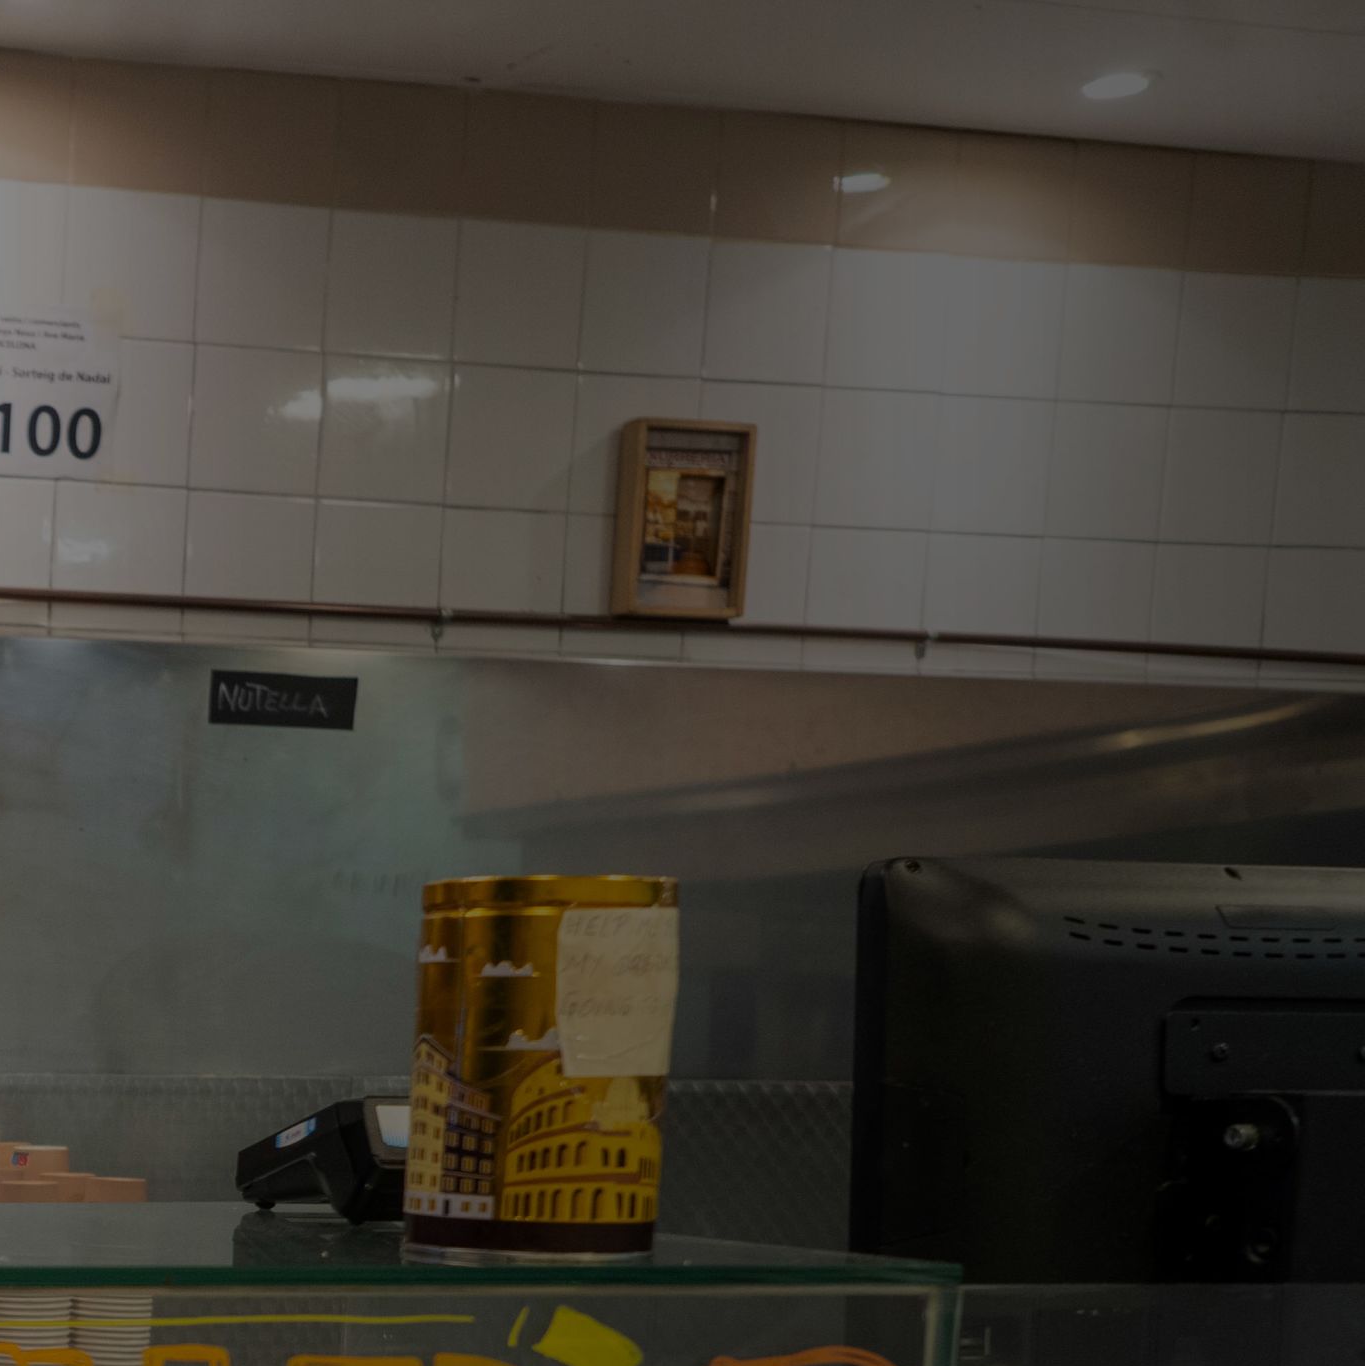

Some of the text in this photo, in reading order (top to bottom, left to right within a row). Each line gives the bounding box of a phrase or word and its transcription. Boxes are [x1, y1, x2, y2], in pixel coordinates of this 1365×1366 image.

[12, 367, 55, 384] Sorteig
[58, 371, 73, 383] de
[76, 372, 112, 385] Nadal
[219, 680, 332, 720] NUTELLA
